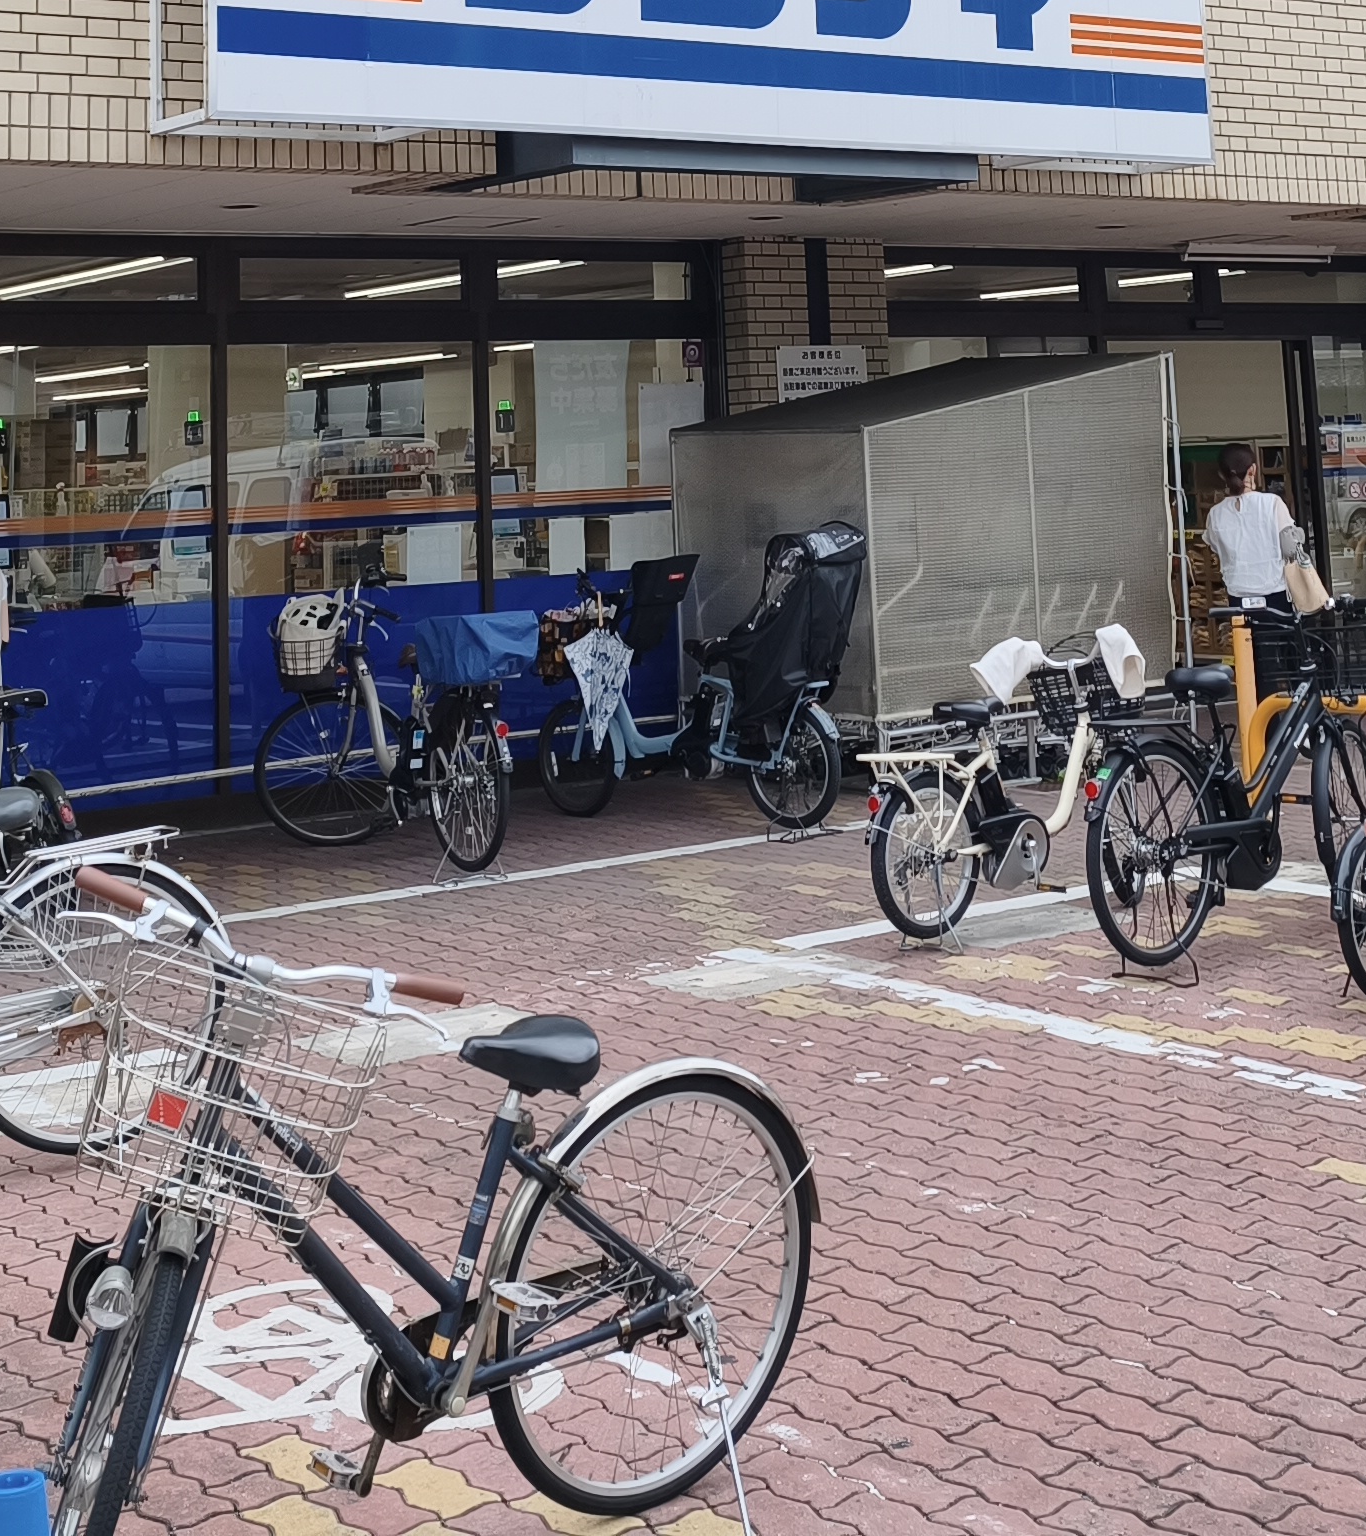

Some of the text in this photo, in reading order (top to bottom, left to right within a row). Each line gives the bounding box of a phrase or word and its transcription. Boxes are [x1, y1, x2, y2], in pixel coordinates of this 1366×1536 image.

[801, 350, 841, 360] お客様各位
